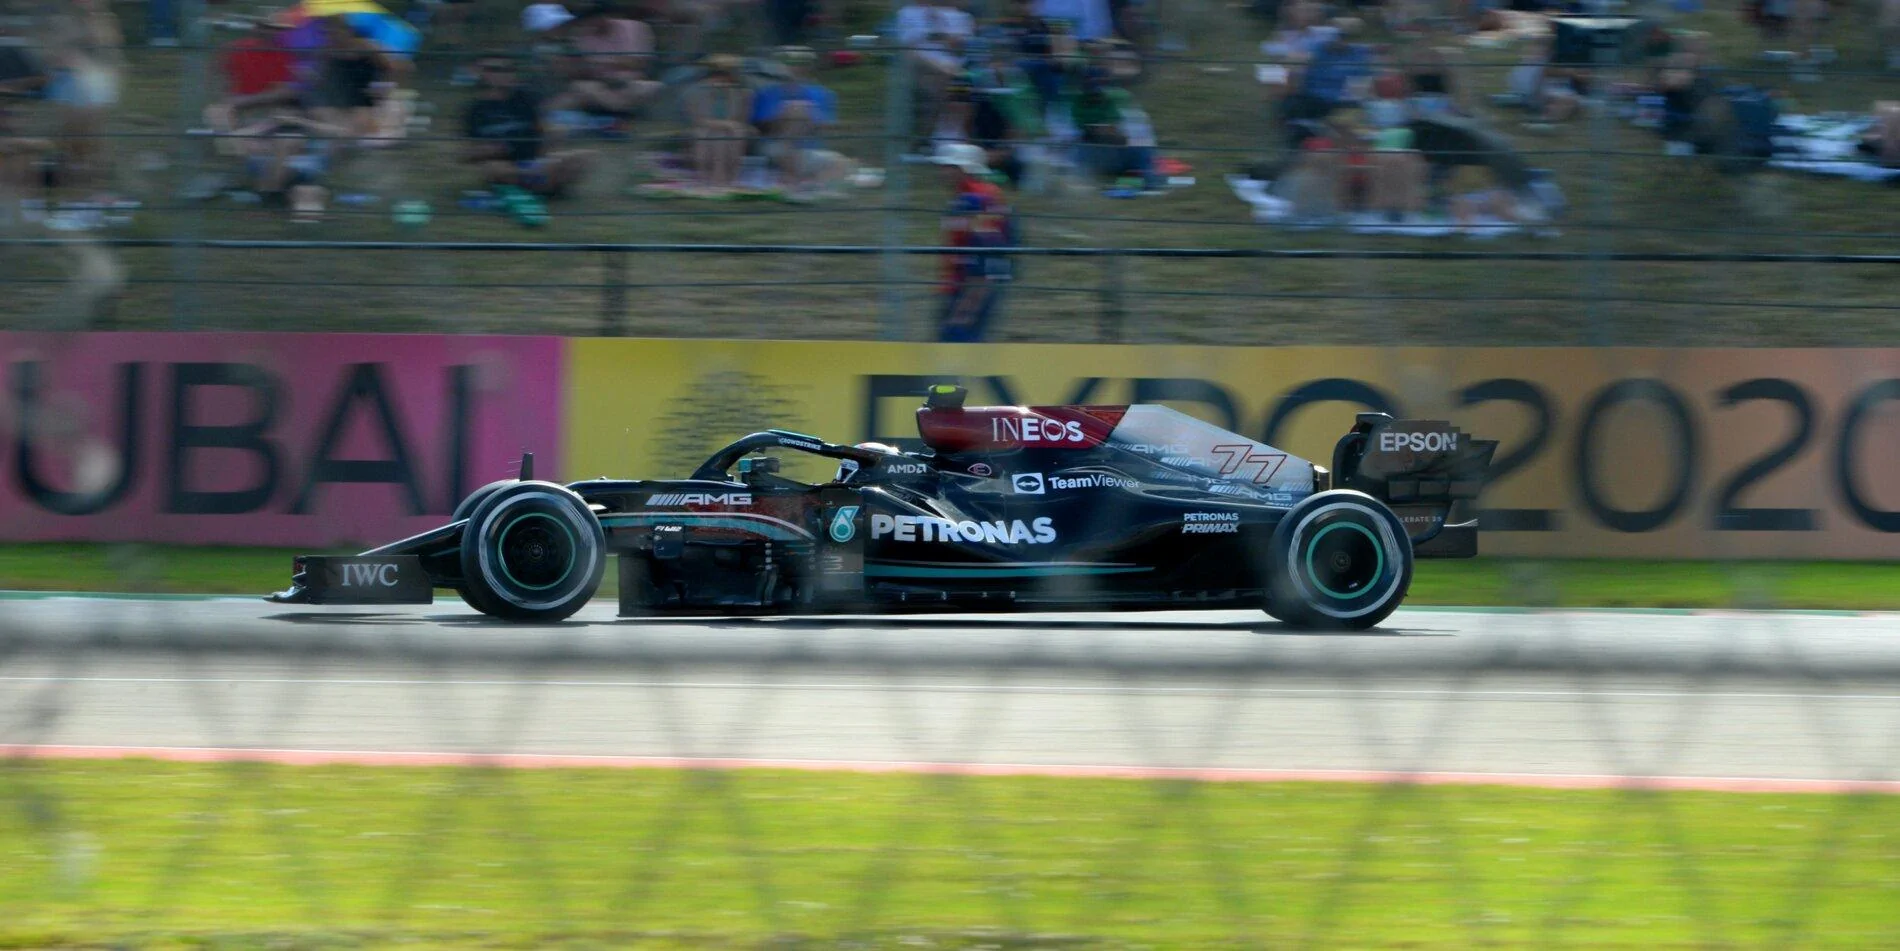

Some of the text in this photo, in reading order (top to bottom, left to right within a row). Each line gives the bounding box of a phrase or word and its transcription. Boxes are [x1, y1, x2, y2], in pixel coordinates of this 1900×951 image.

[992, 417, 1085, 442] INEOS
[1380, 432, 1457, 452] EPSON
[888, 464, 917, 474] AMD
[1211, 444, 1287, 484] 77
[1048, 474, 1141, 489] TeamViewer
[679, 493, 752, 505] AMG
[1239, 488, 1293, 501] AMG
[1184, 512, 1239, 521] PETRONAS
[871, 513, 1056, 544] PETRONAS
[1182, 524, 1239, 534] PRIMAX
[342, 563, 398, 587] IWC
